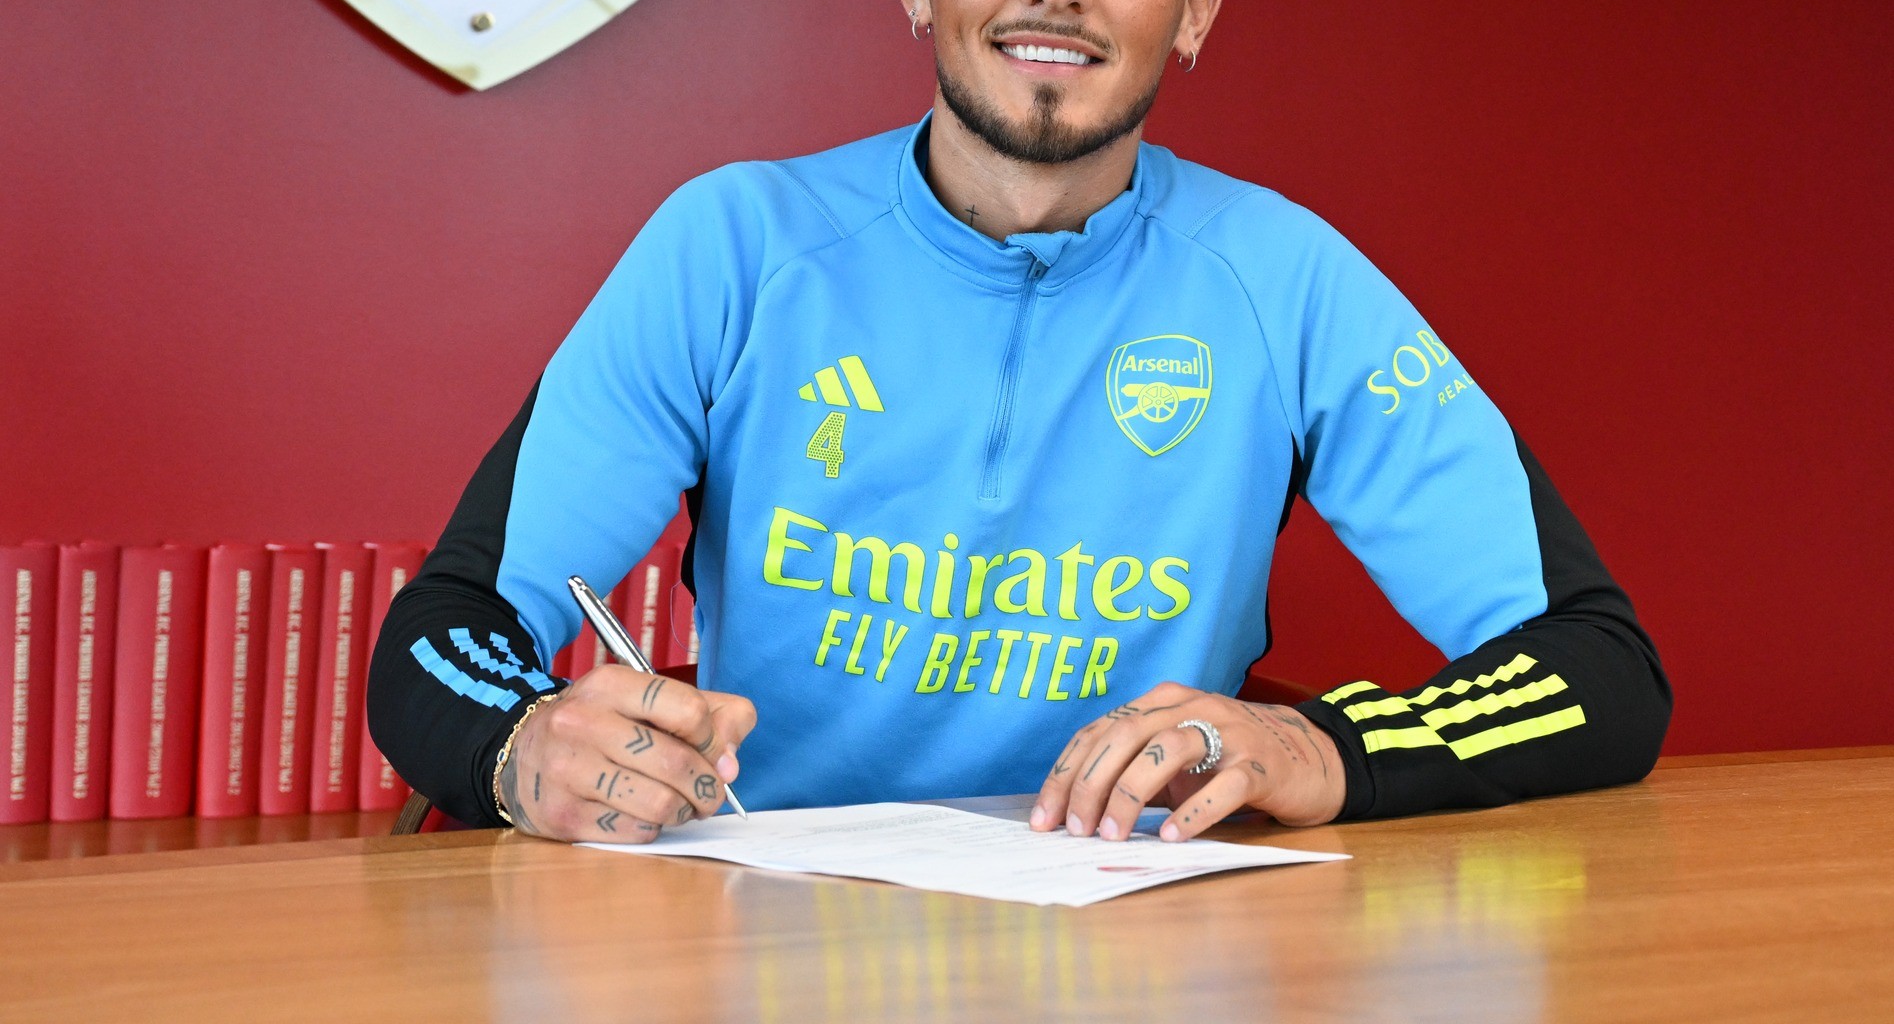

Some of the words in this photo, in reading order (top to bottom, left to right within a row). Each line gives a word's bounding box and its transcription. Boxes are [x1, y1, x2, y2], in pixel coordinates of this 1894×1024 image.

[1121, 354, 1199, 376] Arsenal
[805, 411, 847, 478] 4
[763, 506, 1192, 622] Emirates
[814, 608, 910, 683] FLY
[914, 629, 1120, 701] BETTER
